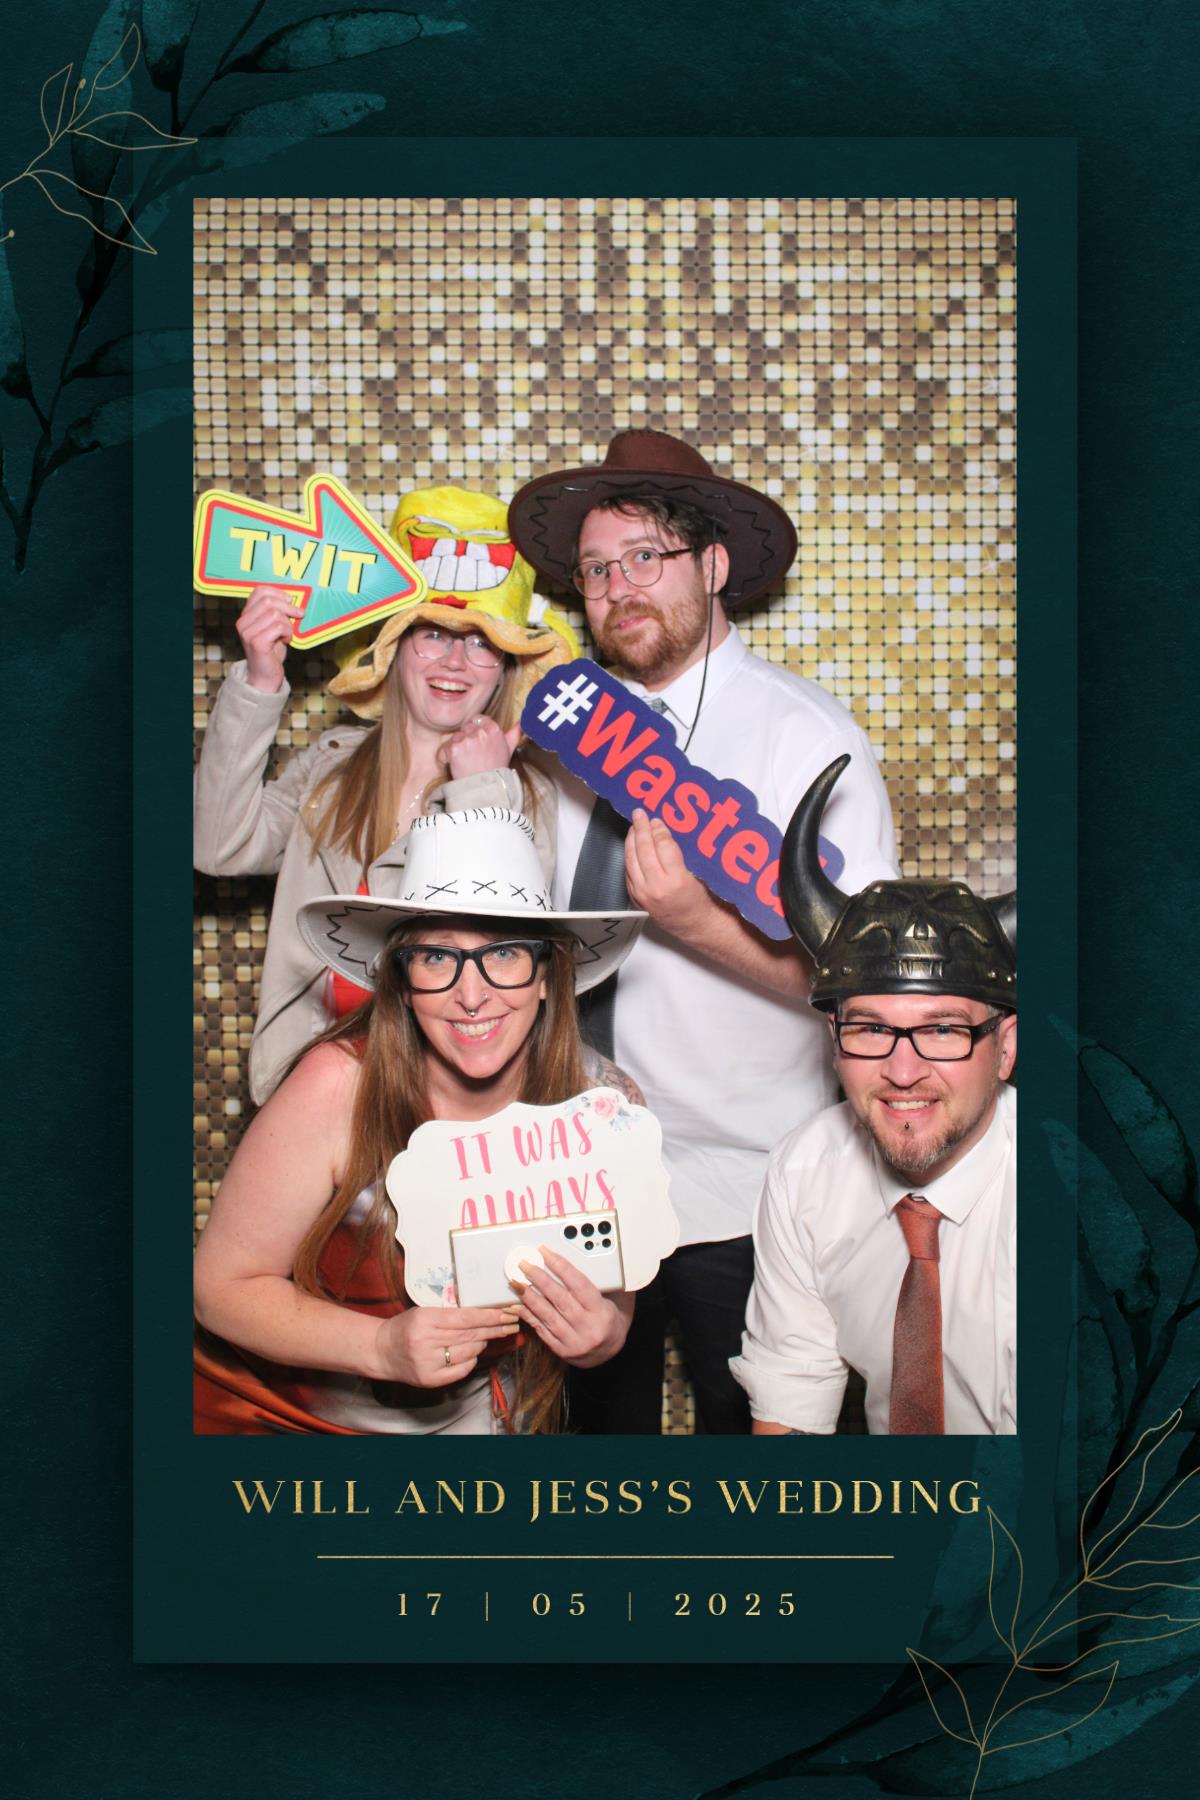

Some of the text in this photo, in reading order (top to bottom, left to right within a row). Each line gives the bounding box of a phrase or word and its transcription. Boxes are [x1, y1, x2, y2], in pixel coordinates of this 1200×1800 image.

[230, 527, 377, 596] TWIT
[450, 1112, 593, 1180] IT WAS
